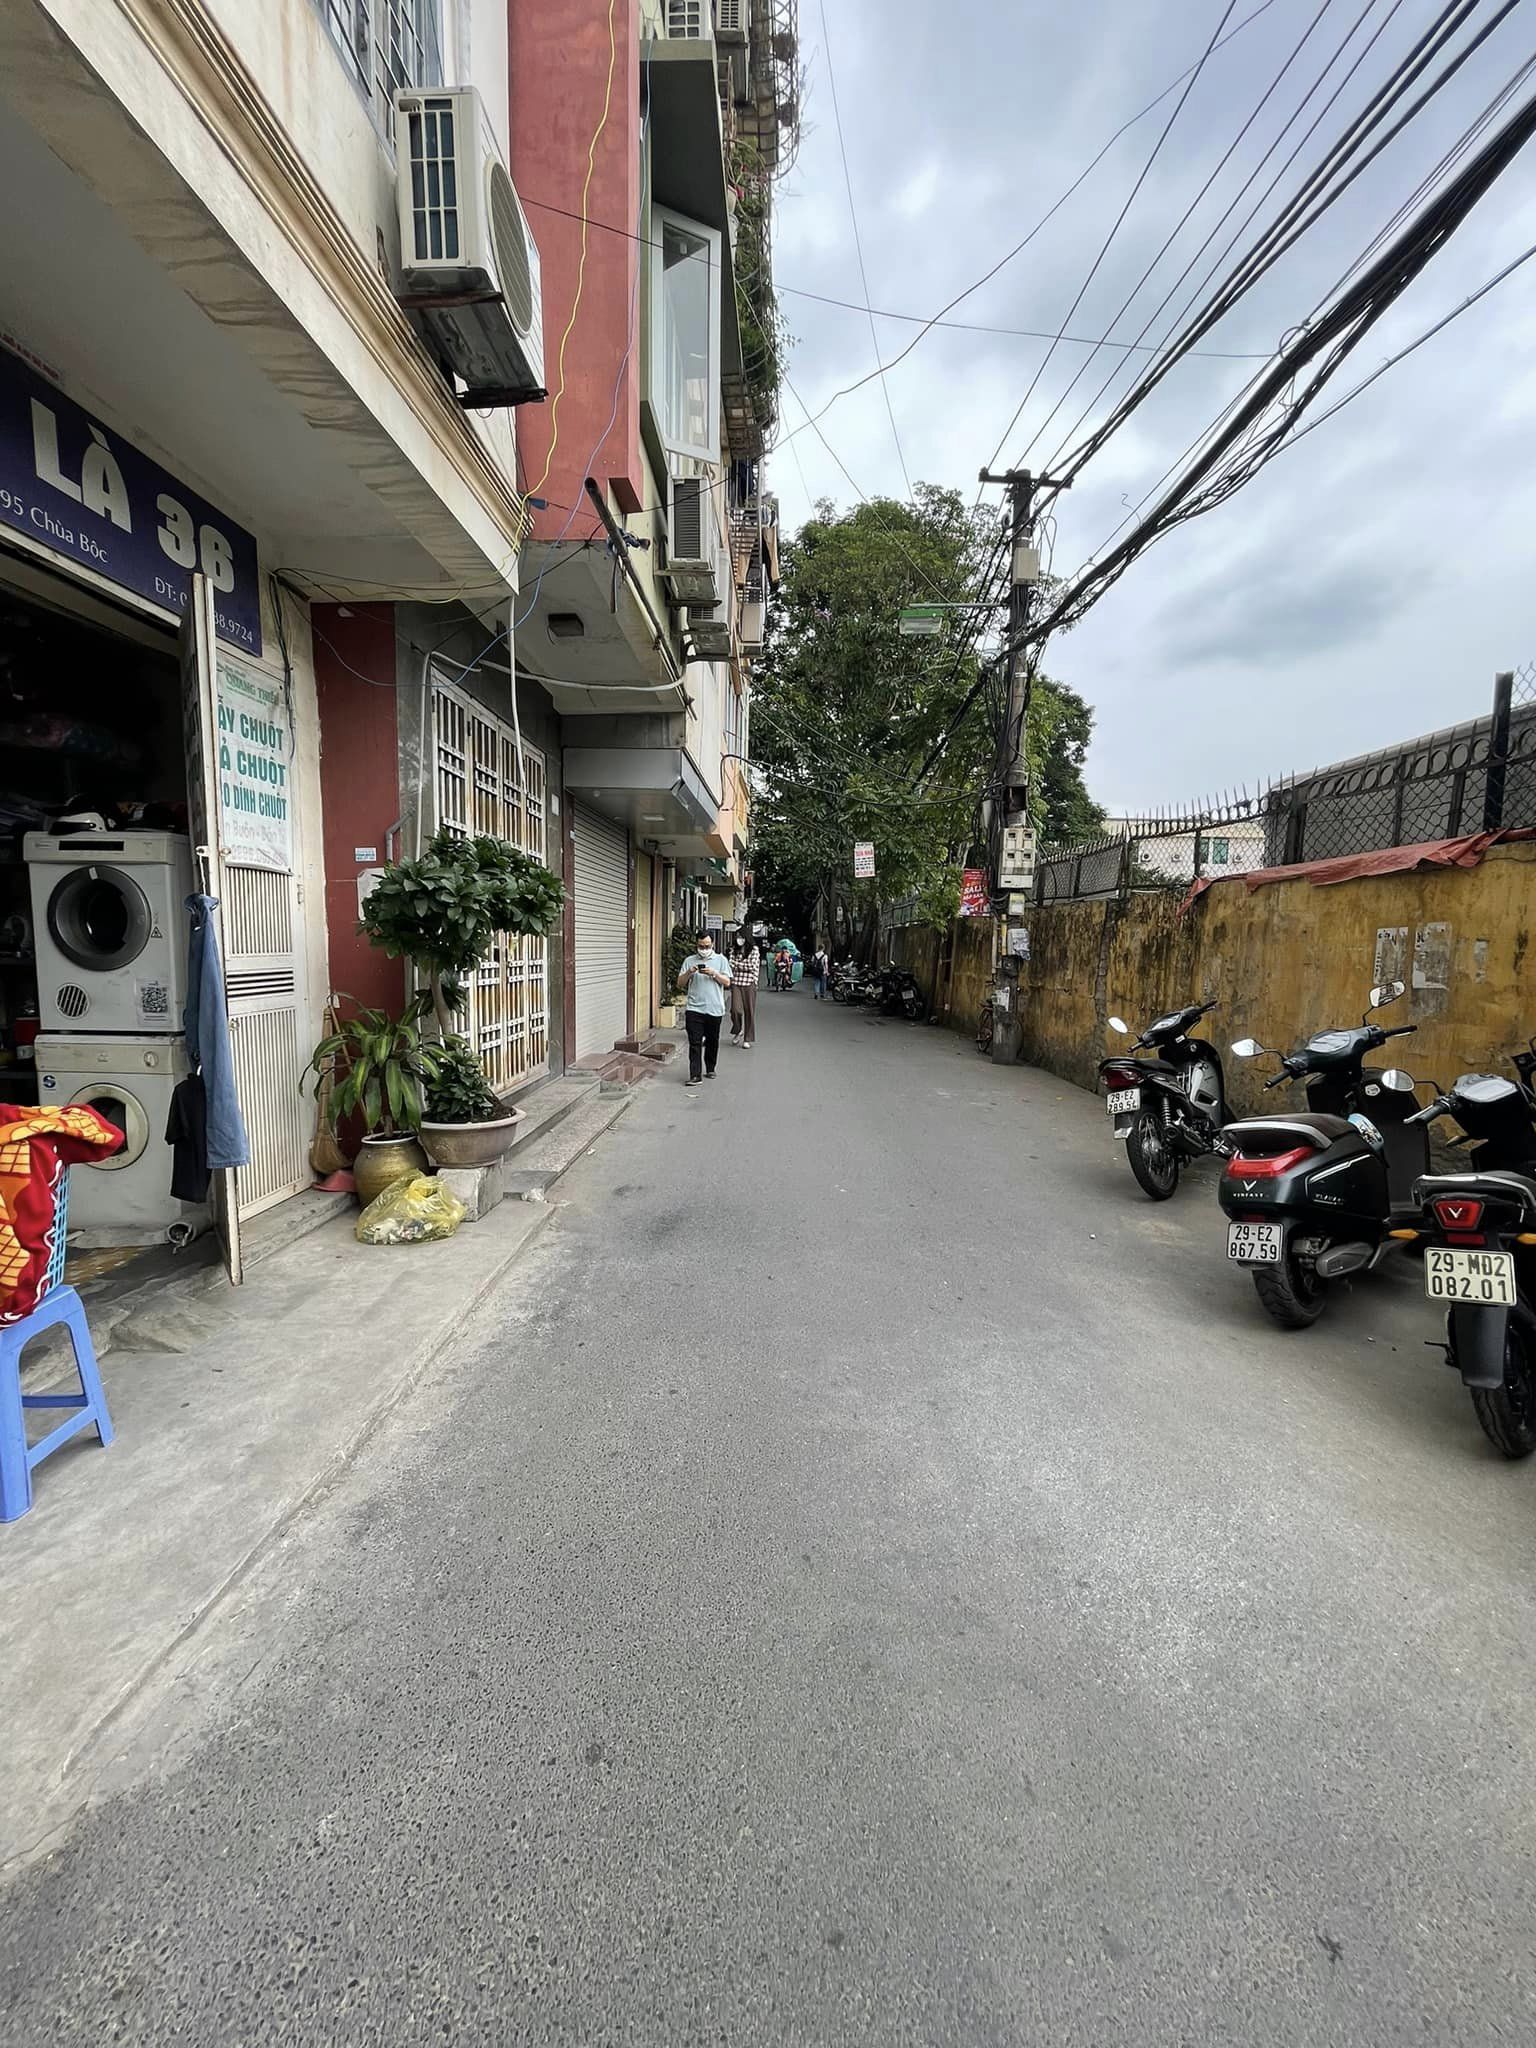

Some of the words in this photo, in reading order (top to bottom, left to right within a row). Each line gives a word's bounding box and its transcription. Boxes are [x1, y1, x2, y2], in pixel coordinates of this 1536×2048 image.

[31, 396, 132, 534] LÀ
[157, 492, 235, 594] 36
[31, 507, 74, 545] Chùa
[240, 713, 284, 753] CHUỘT
[237, 750, 286, 789] CHUỘT
[233, 781, 256, 814] DÍNH
[259, 791, 287, 824] CHUỘT
[1110, 1090, 1134, 1103] 29-E2
[1230, 1242, 1278, 1260] 867.59
[1235, 1225, 1273, 1242] 29-E2
[1431, 1275, 1508, 1302] 082.01
